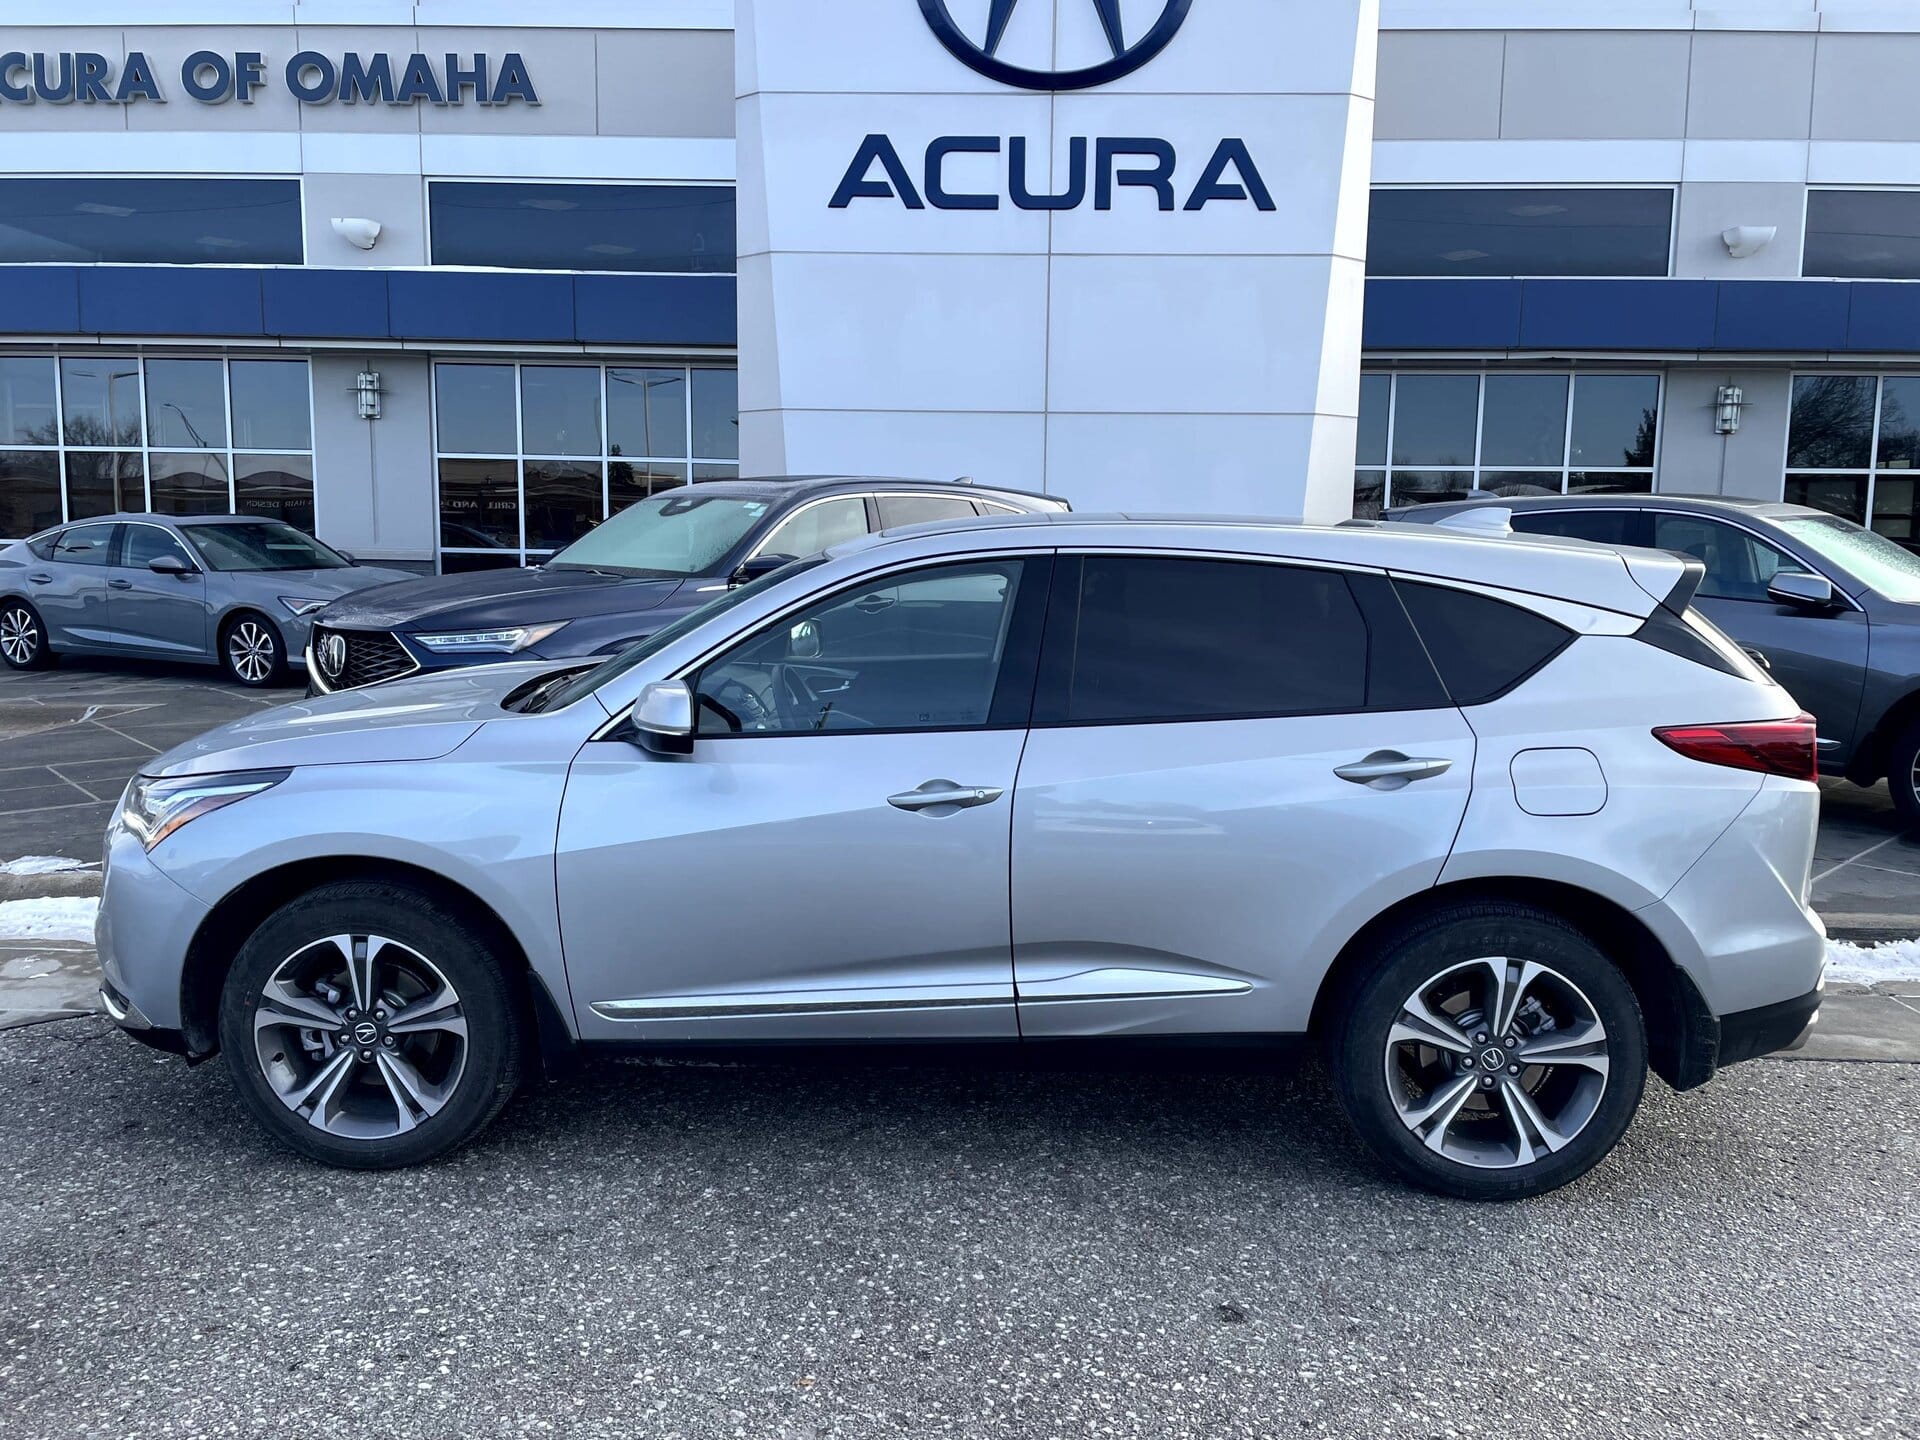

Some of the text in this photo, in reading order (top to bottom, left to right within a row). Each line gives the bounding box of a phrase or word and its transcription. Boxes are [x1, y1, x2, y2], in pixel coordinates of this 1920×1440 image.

[0, 51, 539, 106] CURA OF OMAHA
[828, 134, 1276, 211] ACURA
